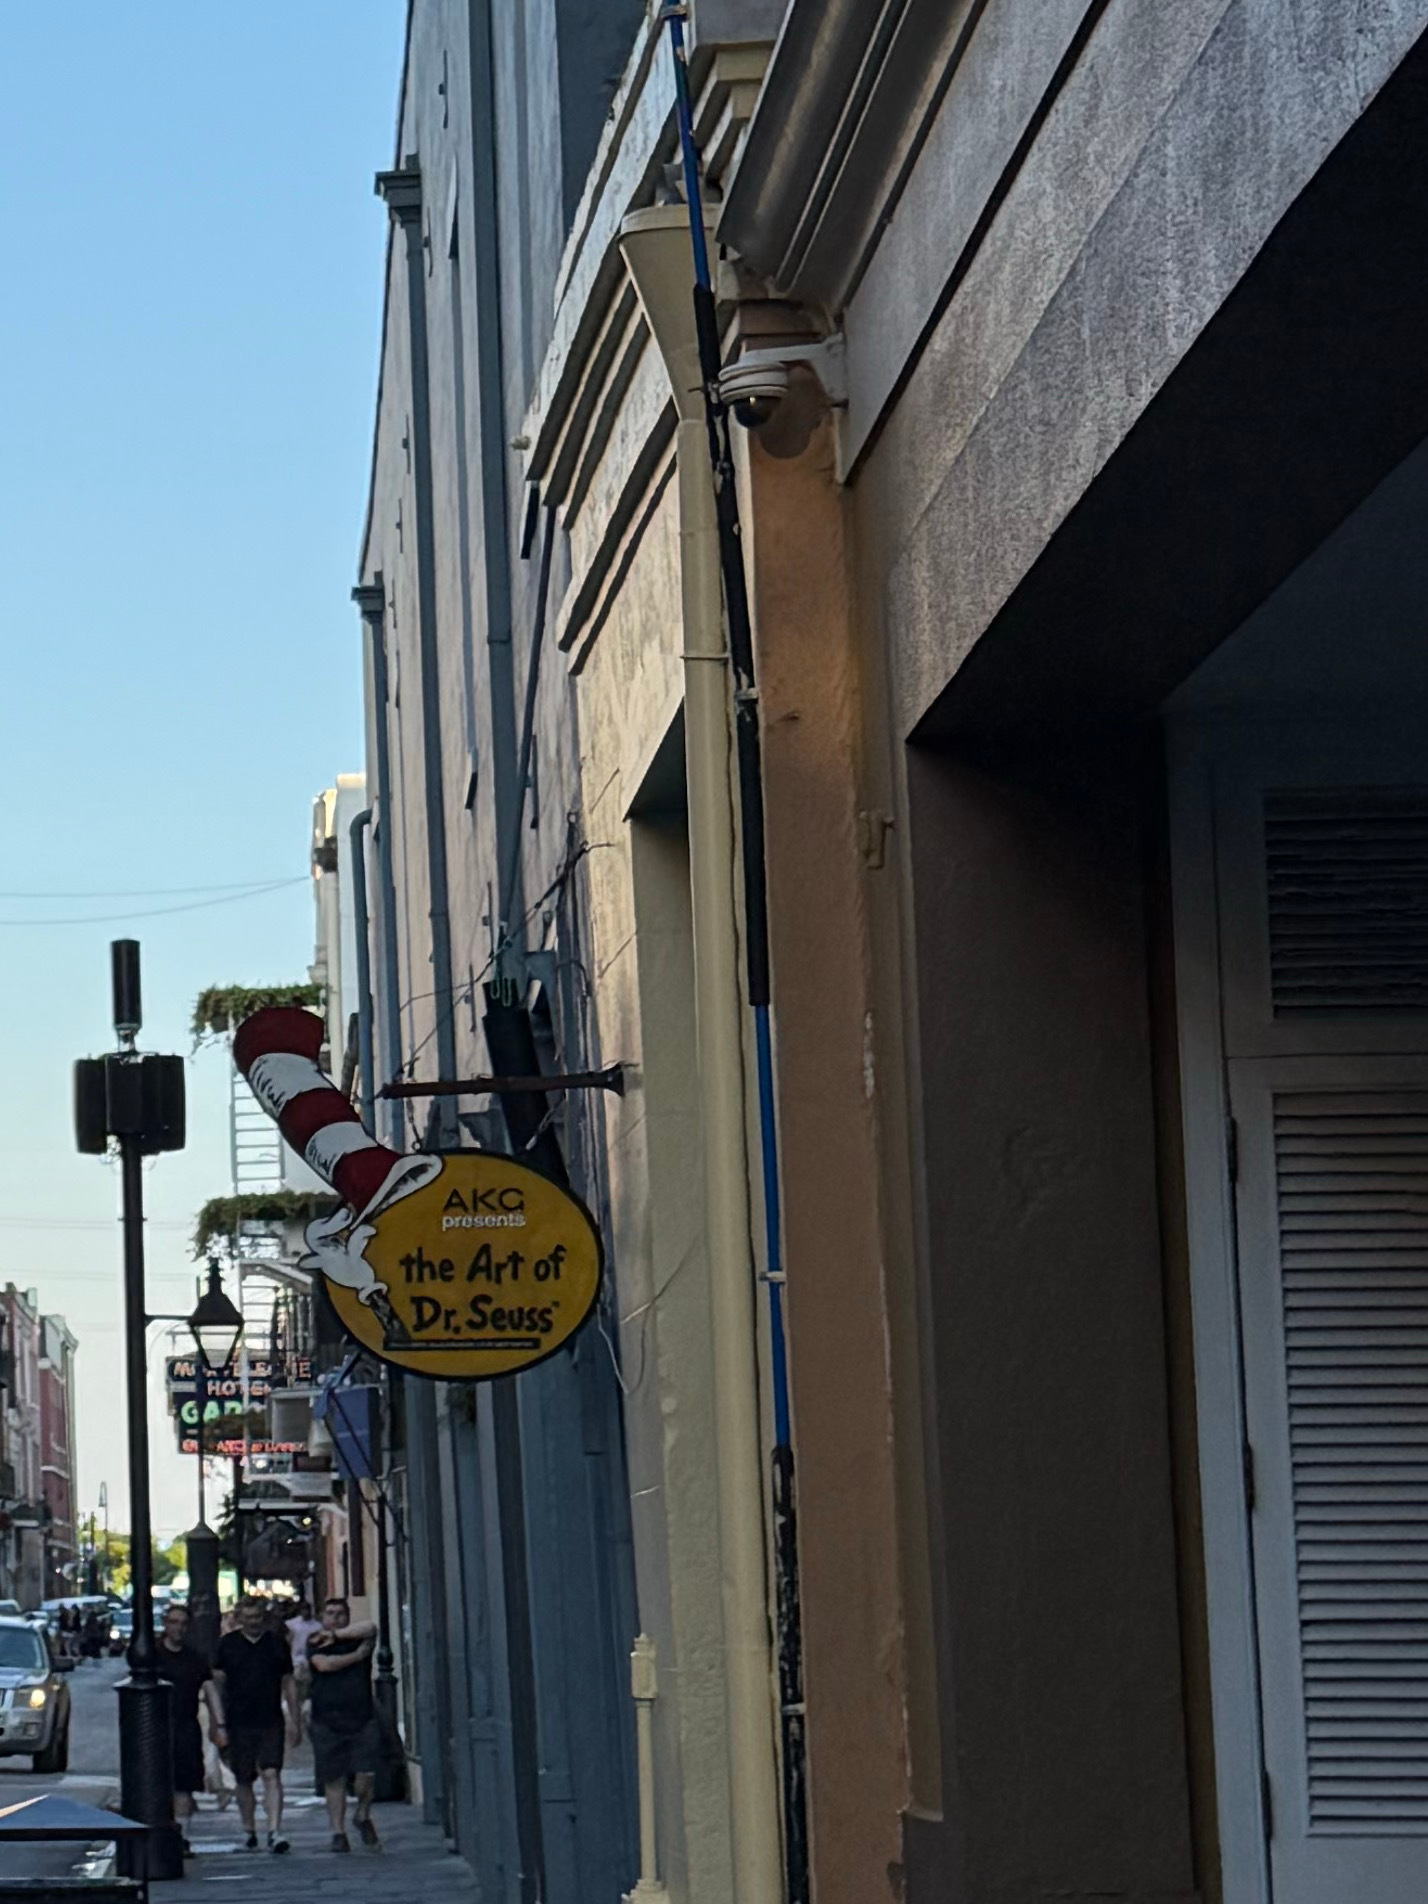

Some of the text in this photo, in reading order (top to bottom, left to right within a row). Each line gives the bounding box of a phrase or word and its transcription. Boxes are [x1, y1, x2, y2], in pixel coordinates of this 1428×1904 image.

[443, 1187, 525, 1213] AKG
[442, 1212, 526, 1231] presents
[399, 1243, 567, 1285] the Art of
[410, 1294, 554, 1334] Dr. Seuss
